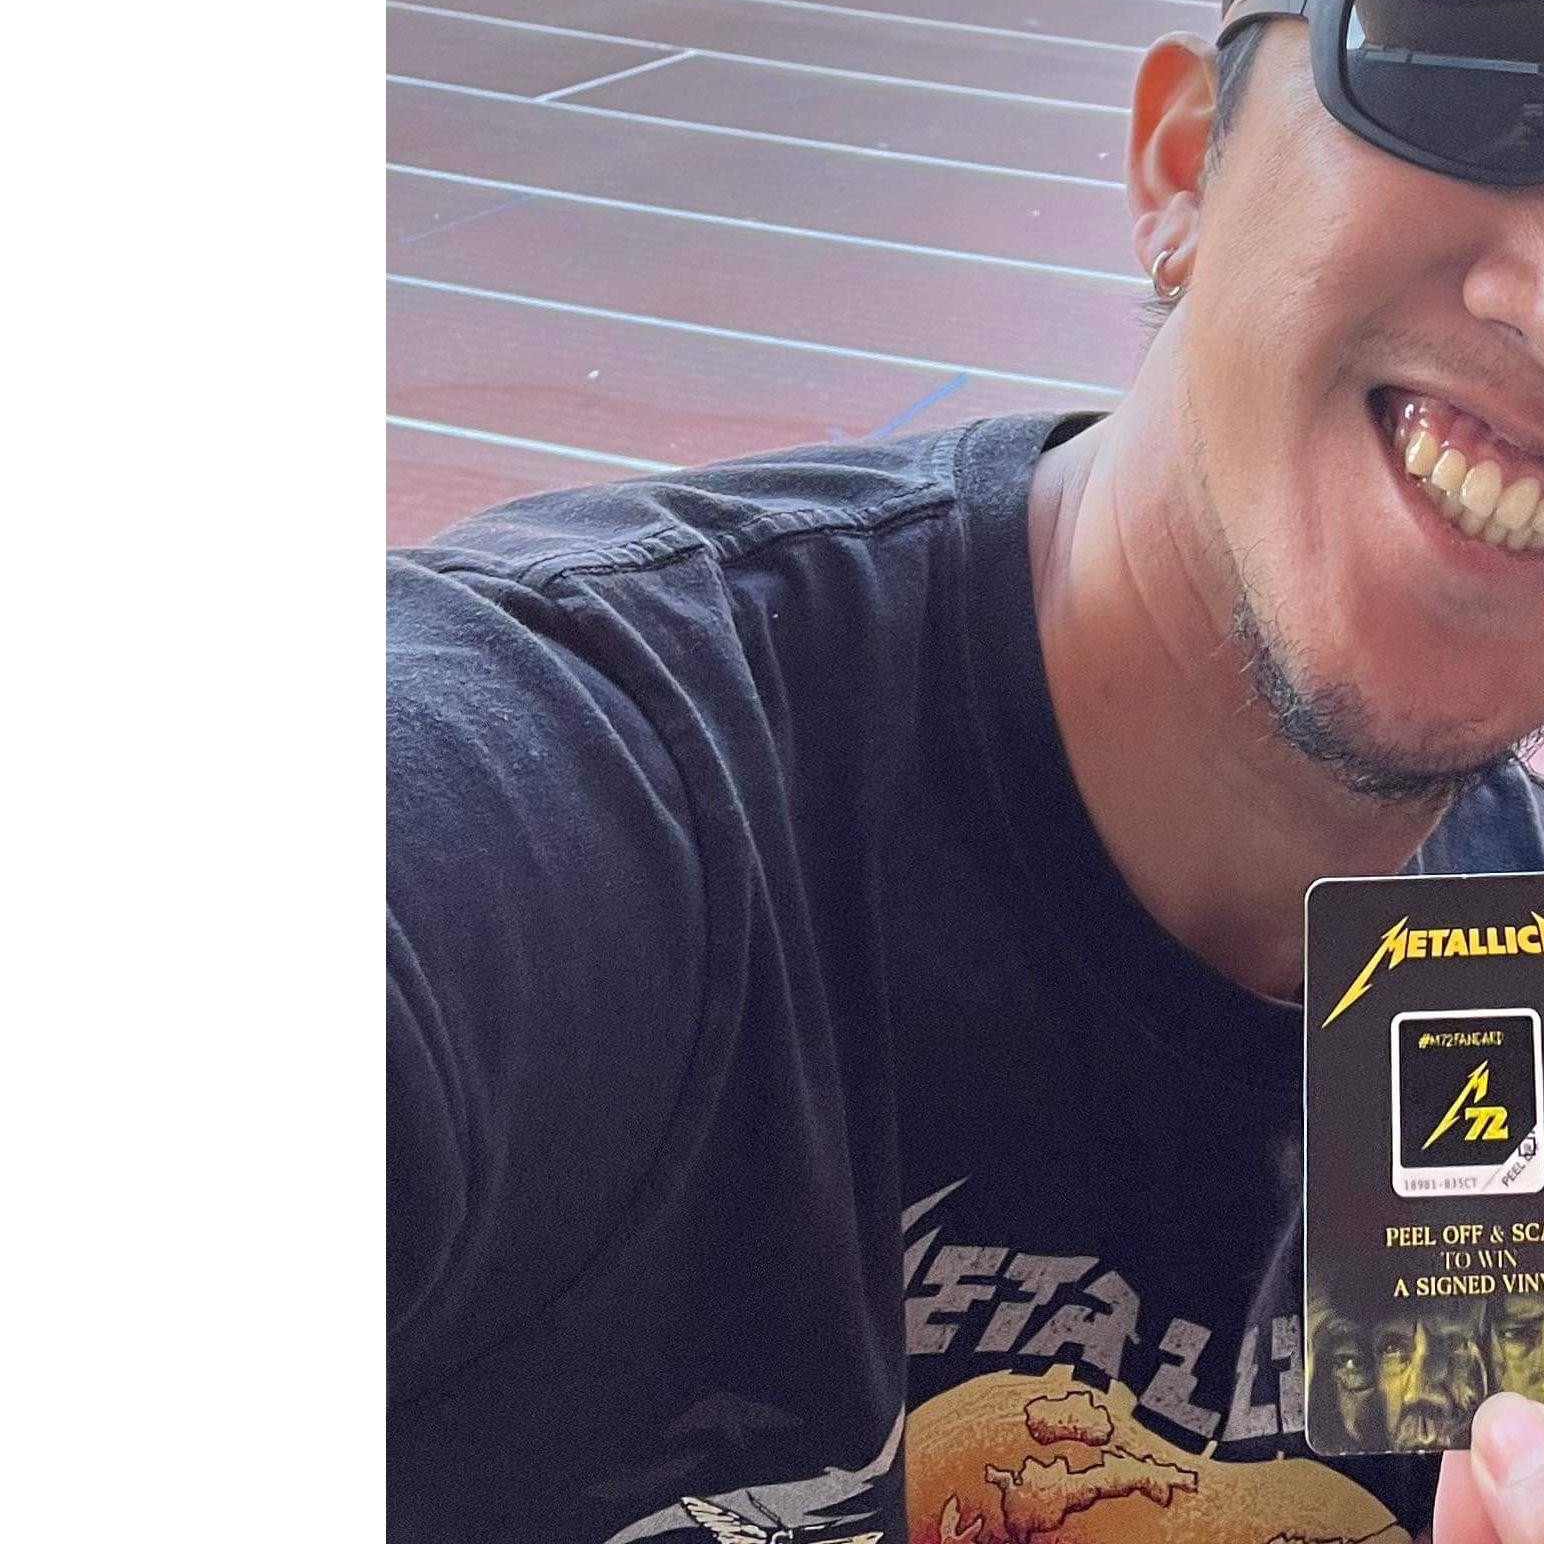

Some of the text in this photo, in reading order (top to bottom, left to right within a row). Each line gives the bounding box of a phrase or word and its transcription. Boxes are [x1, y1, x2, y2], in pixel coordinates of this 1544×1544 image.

[1501, 1161, 1527, 1187] PEEL
[1386, 1227, 1437, 1247] PEEL
[1443, 1225, 1483, 1245] OFF
[1490, 1225, 1504, 1244] &
[1441, 1249, 1517, 1270] TO WIN
[1394, 1278, 1410, 1298] A
[1416, 1274, 1496, 1297] SIGNED
